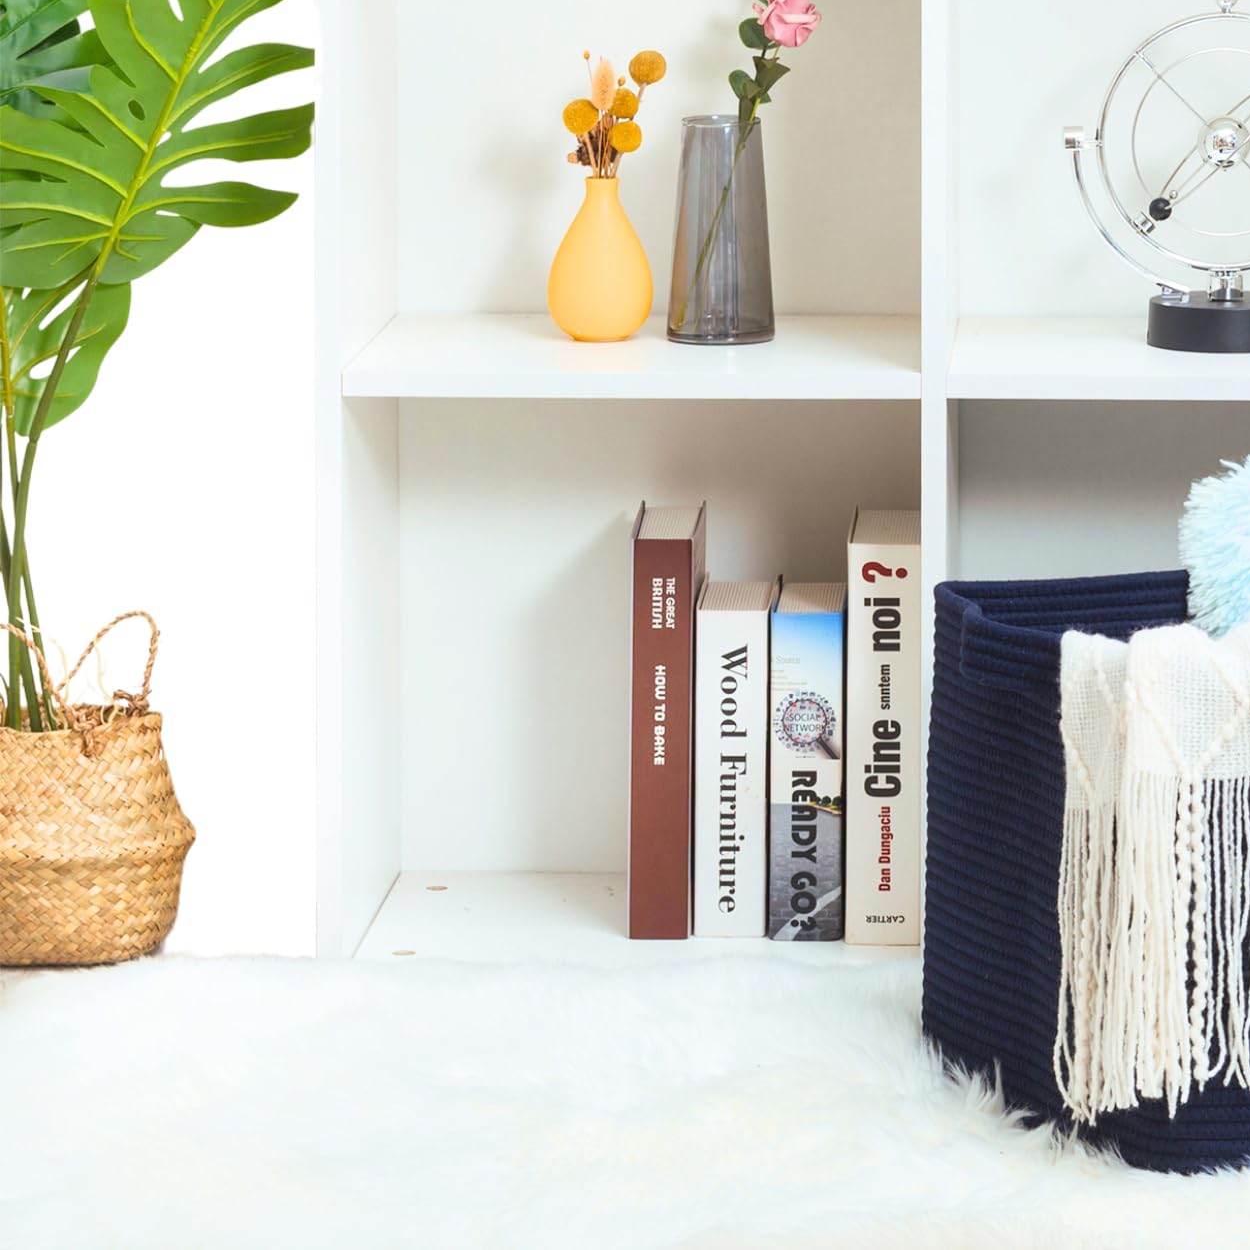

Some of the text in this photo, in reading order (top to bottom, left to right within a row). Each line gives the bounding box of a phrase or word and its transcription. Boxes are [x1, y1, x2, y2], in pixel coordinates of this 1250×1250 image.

[652, 577, 664, 630] BRITISH
[665, 577, 676, 630] THE GREAT
[861, 561, 908, 584] ?
[863, 597, 902, 654] noi
[653, 664, 666, 766] HOW TO BAKE
[719, 643, 749, 914] Wood Furniture
[863, 719, 902, 799] Cine
[791, 770, 817, 864] READY
[877, 806, 893, 892] Dan Dungaciu
[791, 870, 818, 932] GO?
[865, 915, 905, 923] CARTIER
